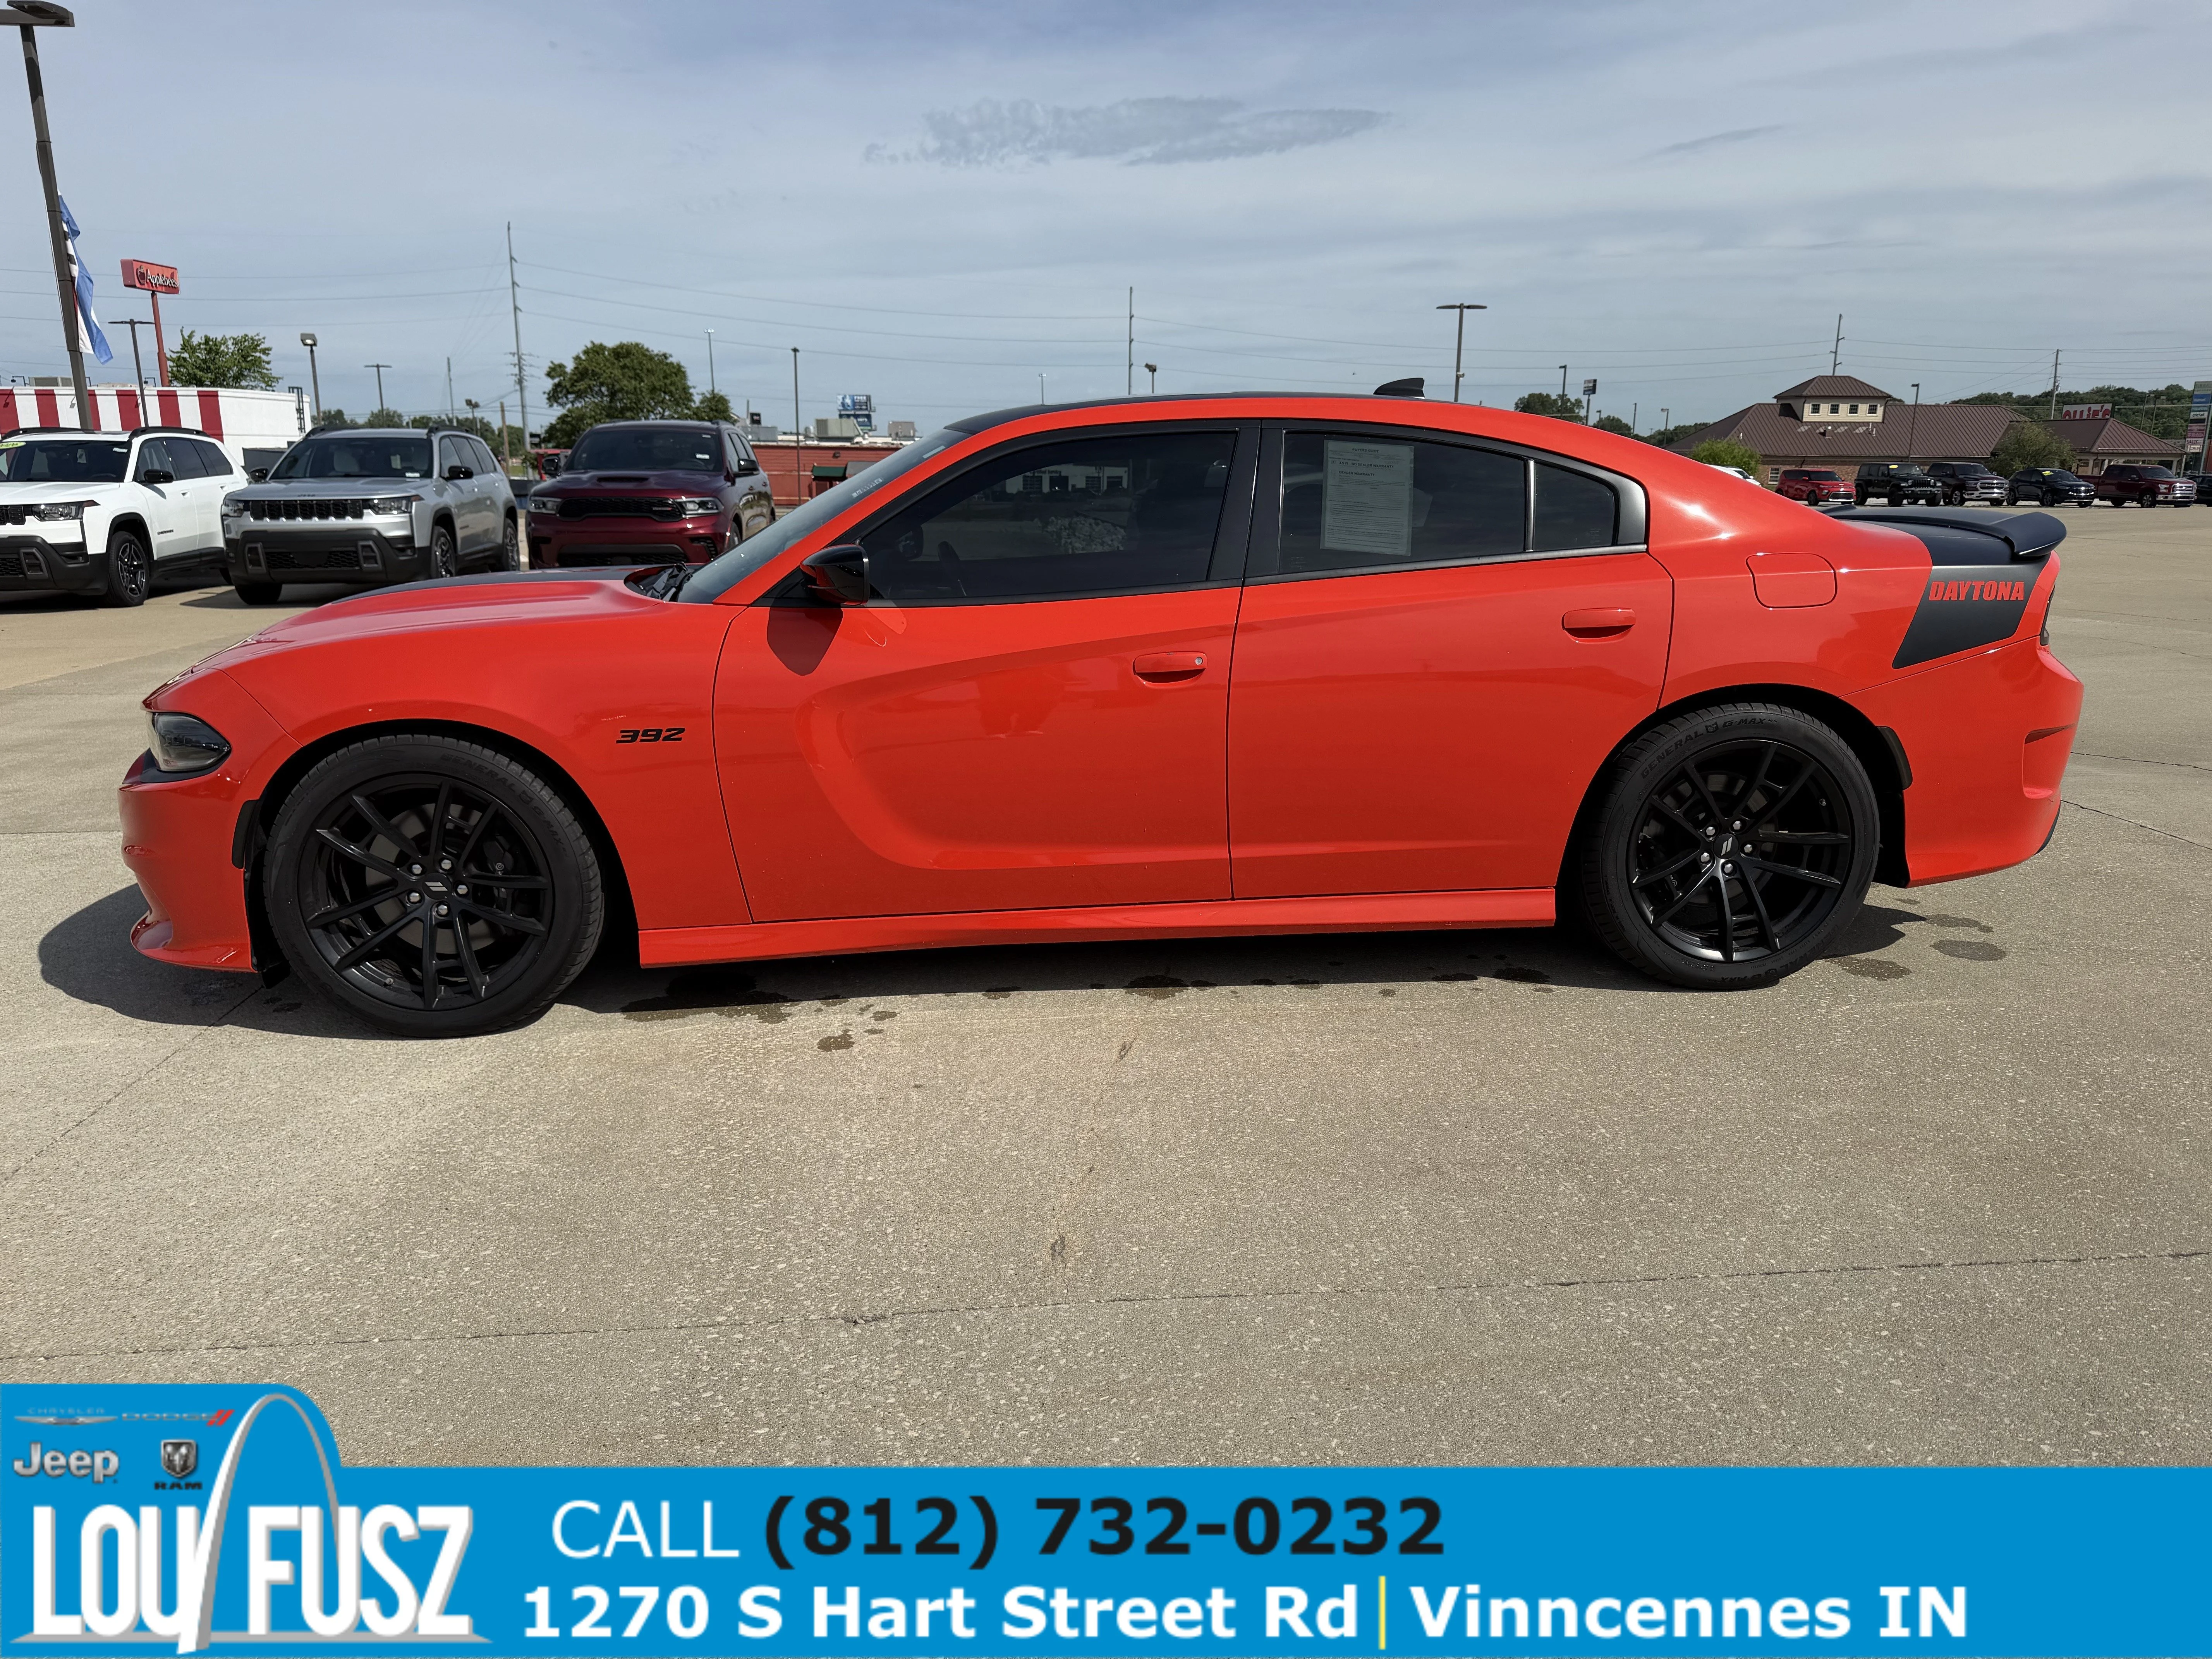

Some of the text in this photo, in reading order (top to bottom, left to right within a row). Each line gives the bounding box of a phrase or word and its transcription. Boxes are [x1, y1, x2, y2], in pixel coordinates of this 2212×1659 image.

[1929, 581, 2025, 601] DAYTONA
[616, 728, 685, 744] 392
[1641, 730, 1704, 779] GENERAL
[440, 753, 516, 795] GENERAL
